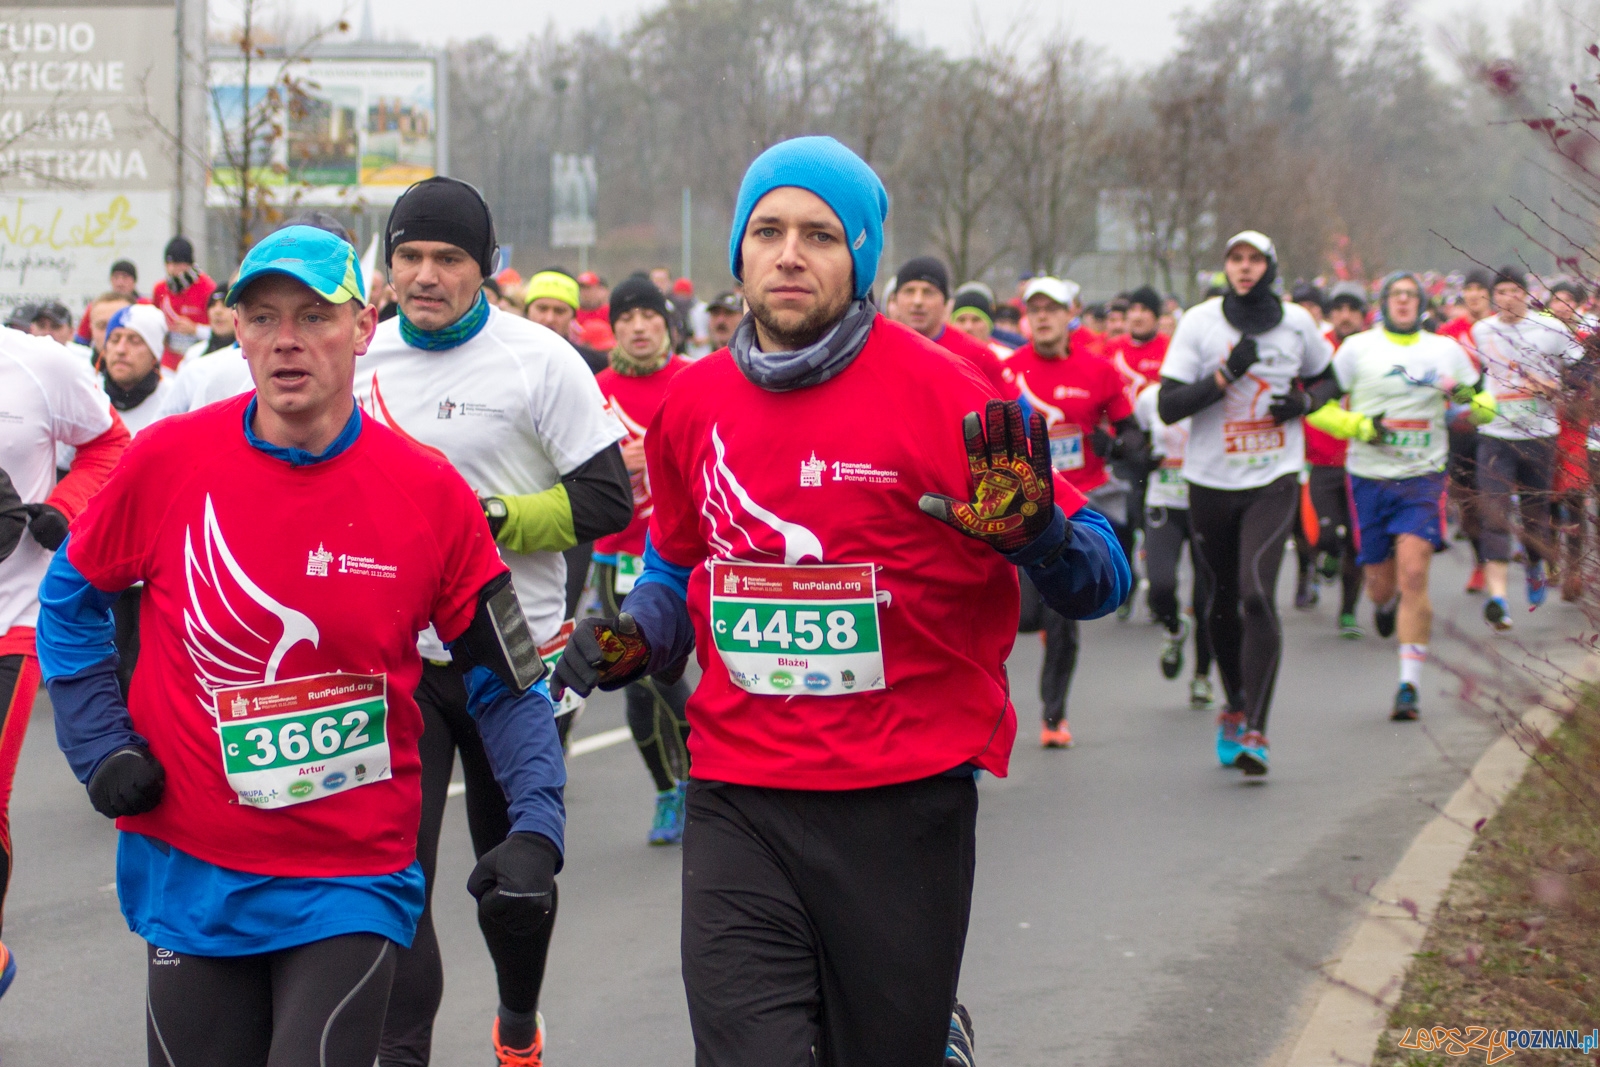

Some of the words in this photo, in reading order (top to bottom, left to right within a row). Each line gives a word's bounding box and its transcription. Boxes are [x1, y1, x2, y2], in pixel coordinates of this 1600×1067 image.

[832, 461, 842, 481] 1
[957, 505, 1006, 532] UNITED
[338, 553, 348, 573] 1
[792, 580, 861, 591] RunPoland.org
[715, 619, 727, 634] C
[732, 608, 859, 651] 4458
[778, 657, 808, 669] Błażej
[308, 683, 374, 700] RunPoland.org
[227, 743, 240, 757] C
[244, 710, 370, 766] 3662
[298, 764, 326, 776] Artur
[152, 957, 181, 967] Kalenji
